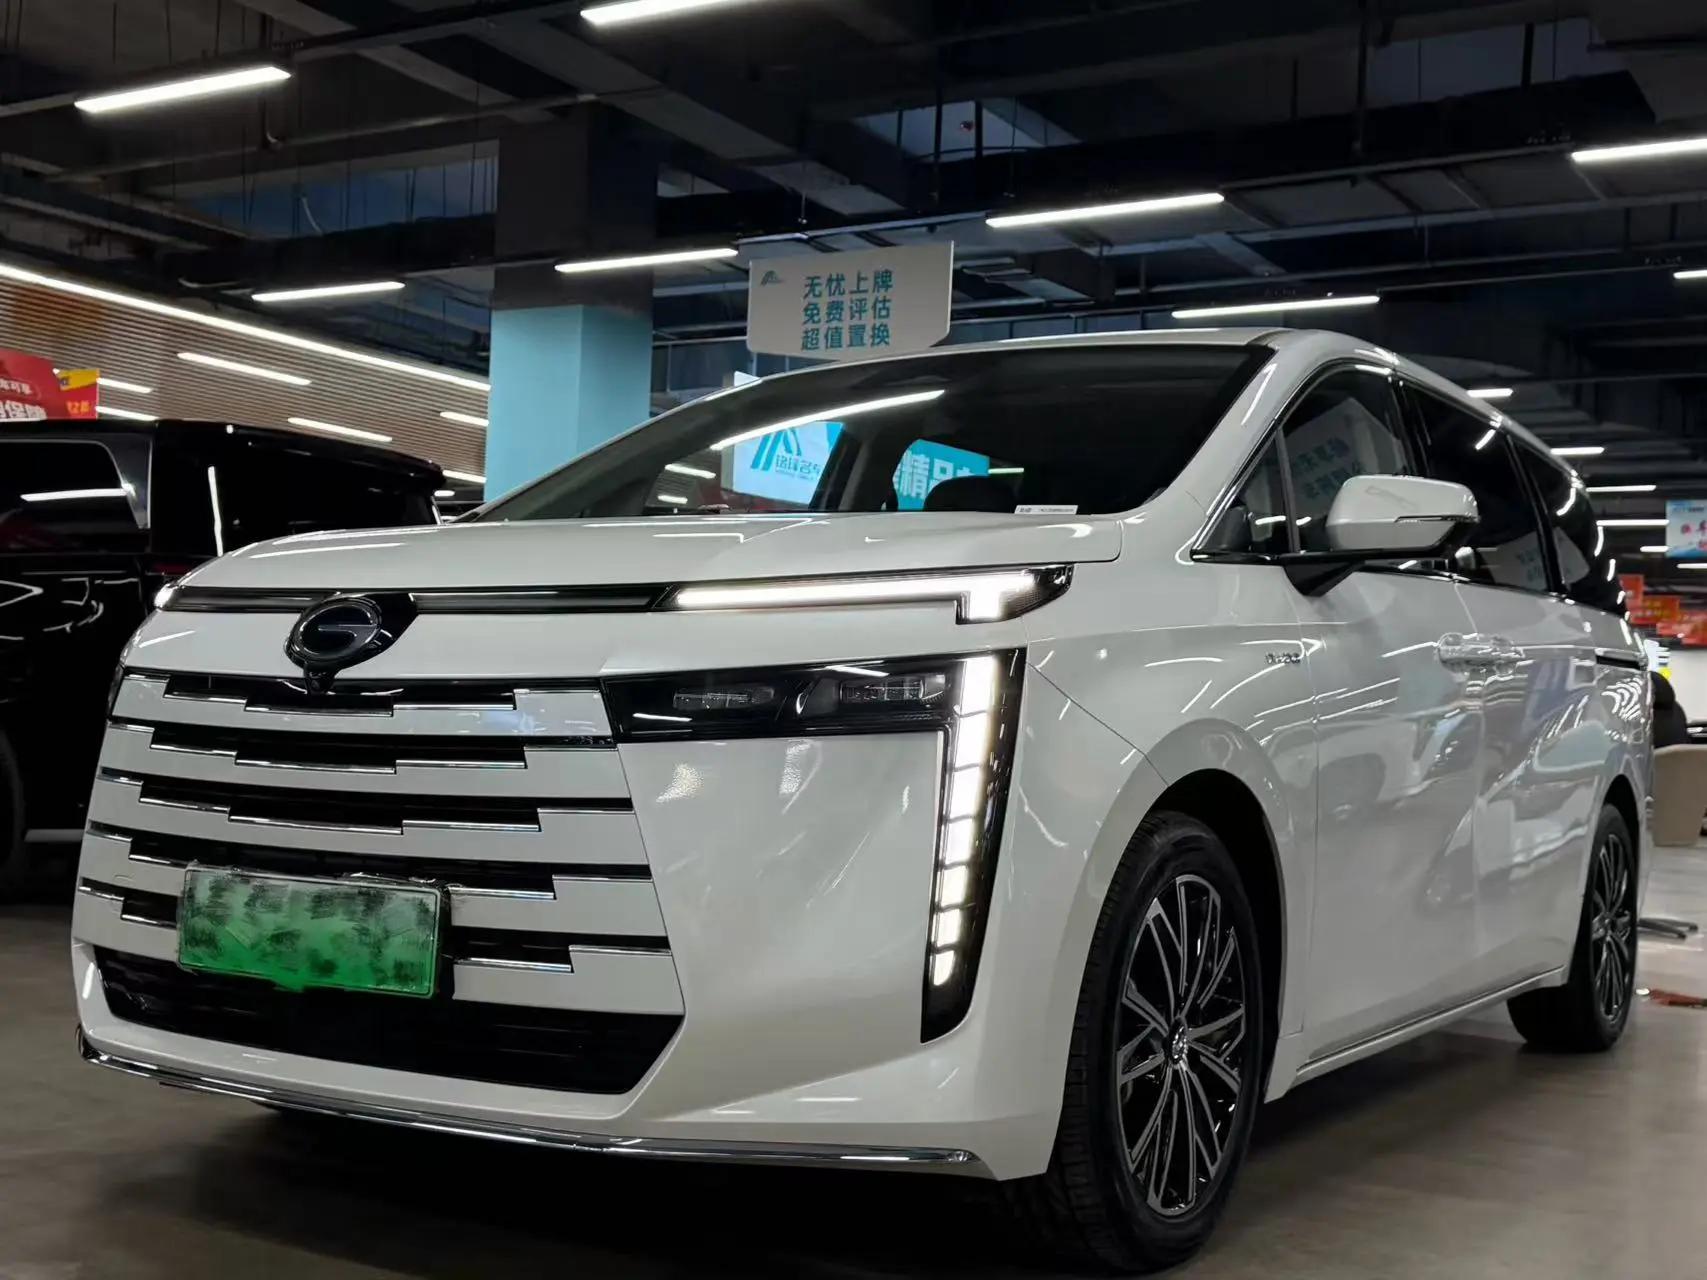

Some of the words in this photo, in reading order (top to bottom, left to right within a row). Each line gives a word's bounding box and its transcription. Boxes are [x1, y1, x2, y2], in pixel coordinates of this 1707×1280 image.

[803, 270, 893, 299] 无忧上牌
[803, 298, 891, 325] 免费评估
[801, 323, 890, 351] 超值置换
